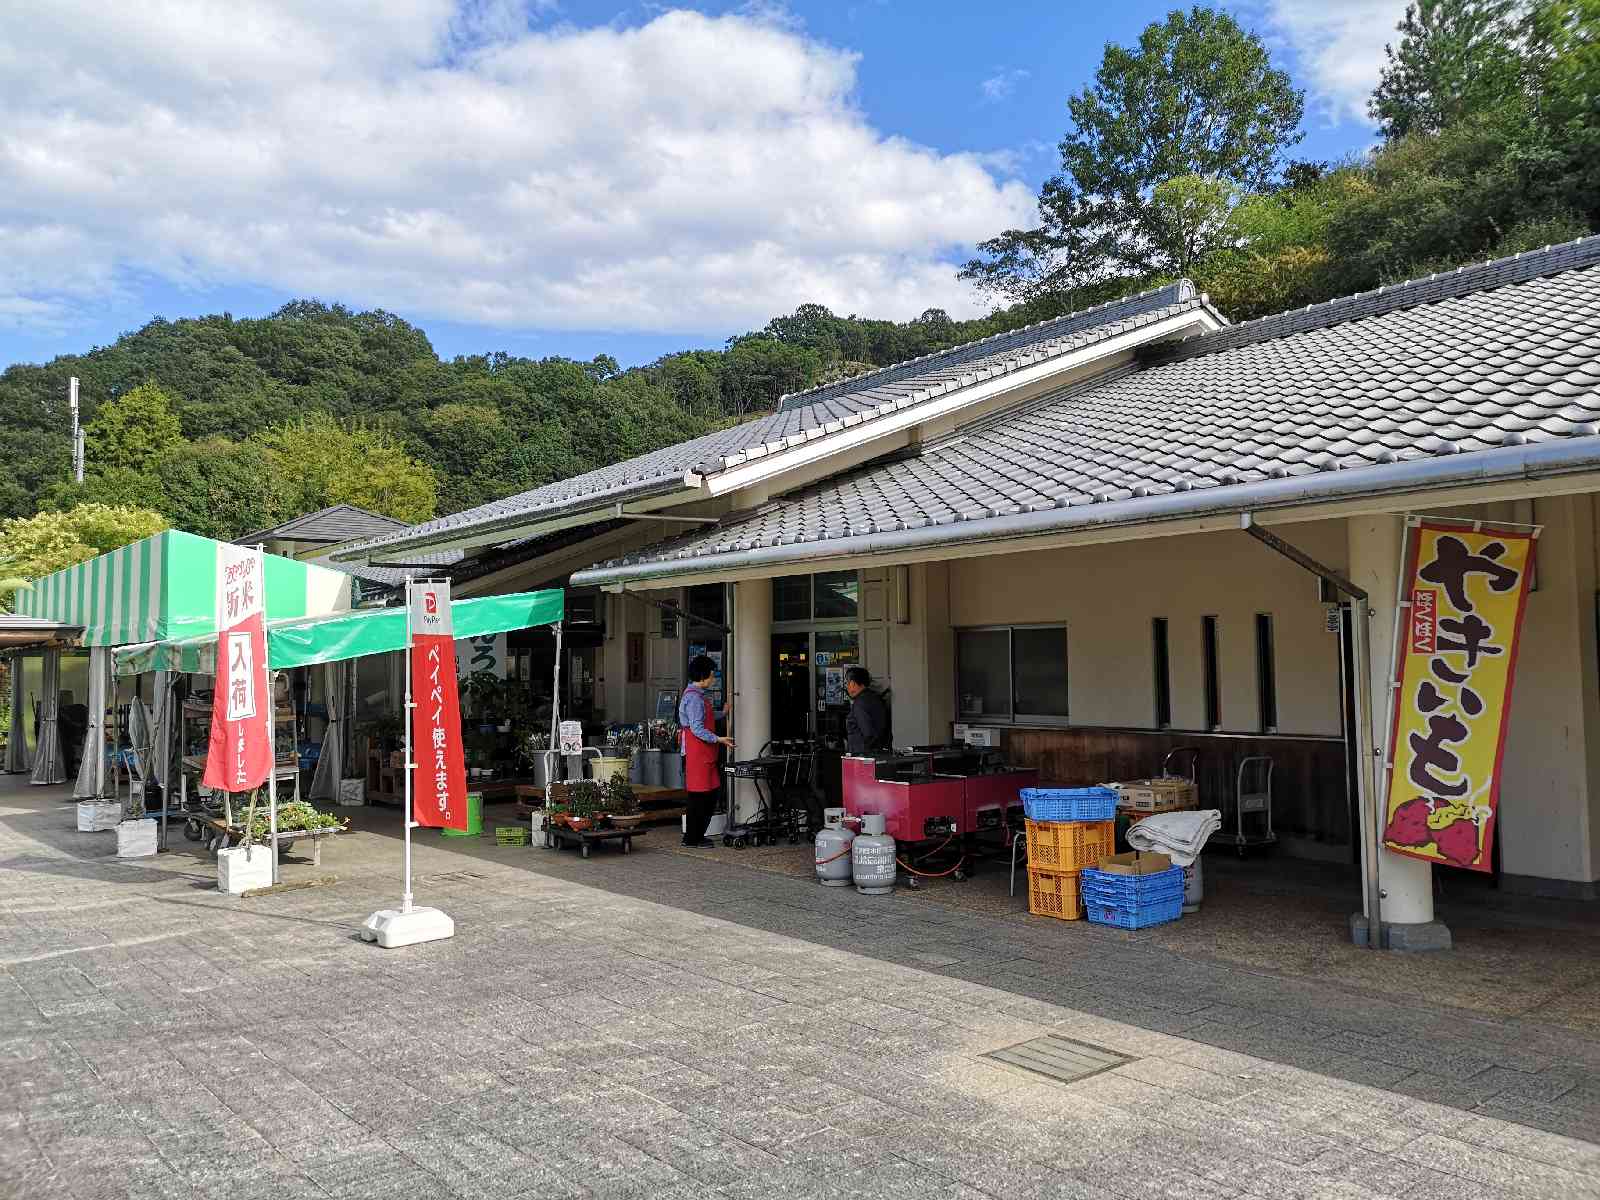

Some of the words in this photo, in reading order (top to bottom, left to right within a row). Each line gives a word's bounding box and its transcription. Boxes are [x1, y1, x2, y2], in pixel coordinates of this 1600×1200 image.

[236, 723, 248, 785] しました
[428, 644, 451, 821] ペイペイ使えます。
[1409, 535, 1519, 797] やきいも
